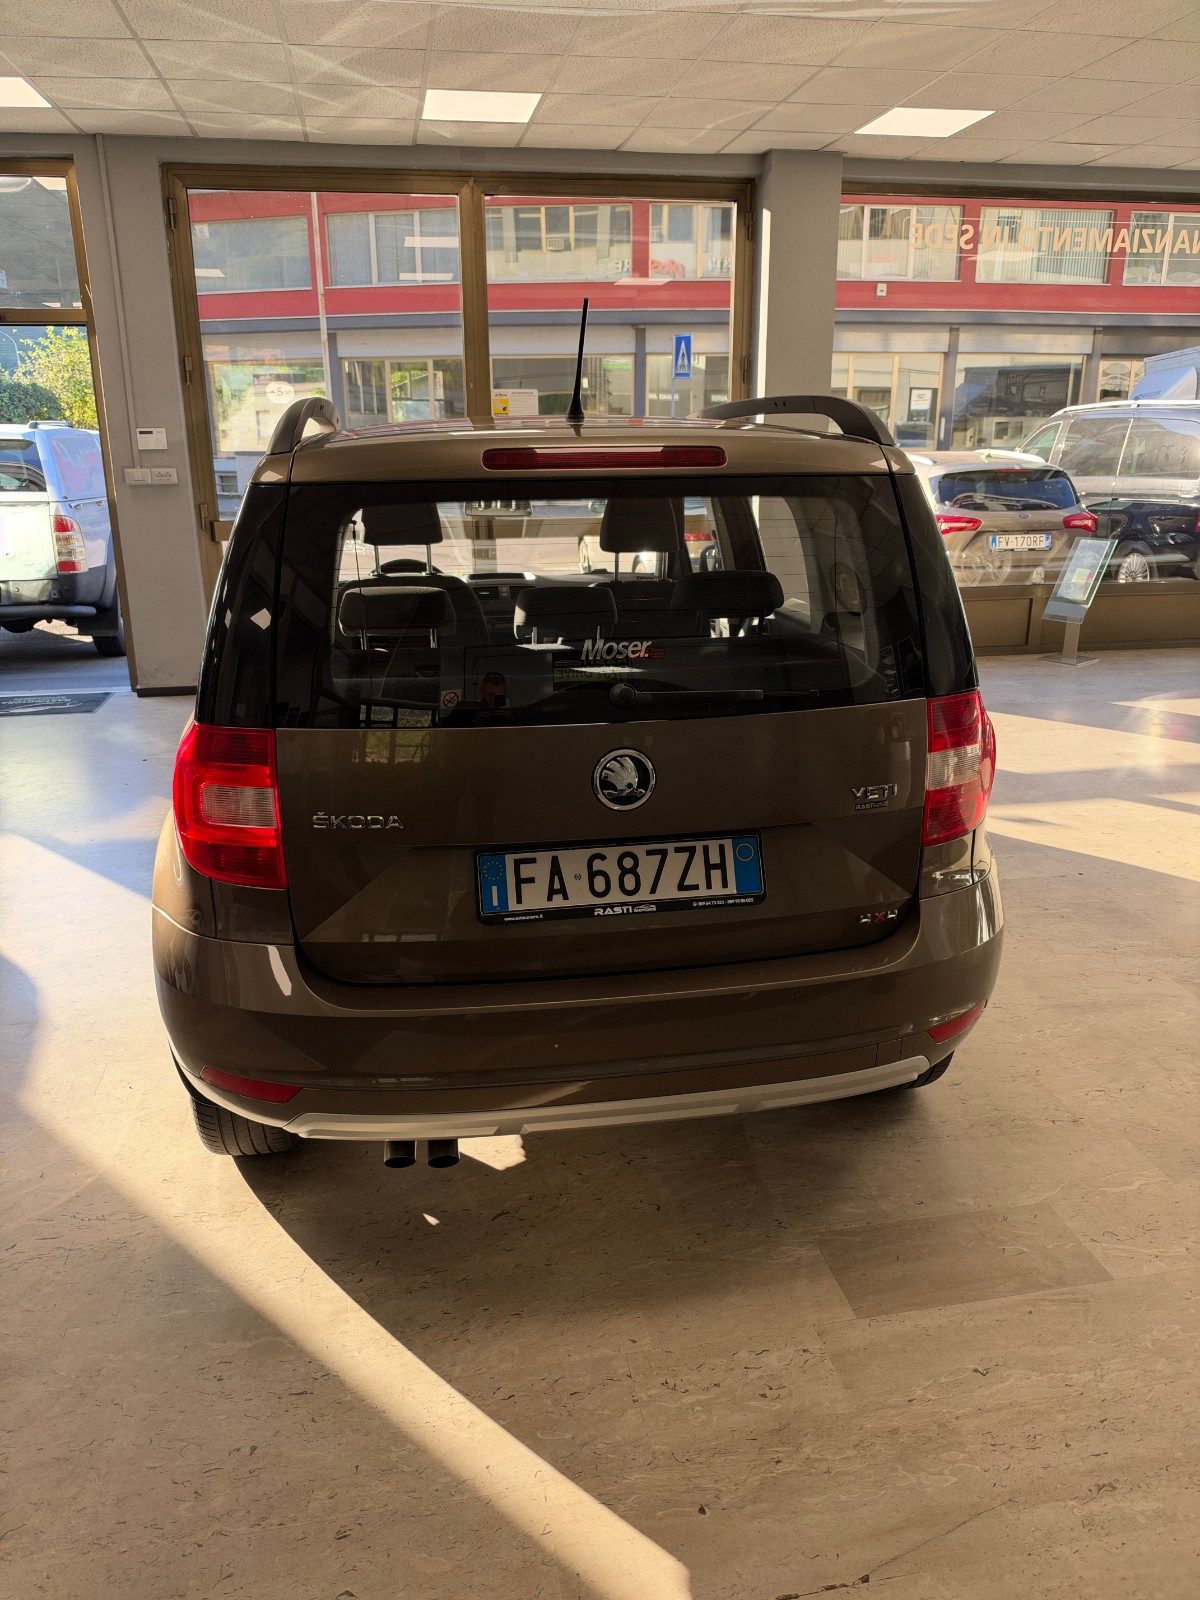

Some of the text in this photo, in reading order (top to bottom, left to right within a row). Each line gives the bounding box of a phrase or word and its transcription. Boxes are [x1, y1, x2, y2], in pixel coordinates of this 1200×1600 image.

[851, 783, 898, 800] YETI
[312, 811, 404, 829] ŠKODA
[513, 843, 729, 904] FA 687ZH
[593, 905, 633, 916] RASTI
